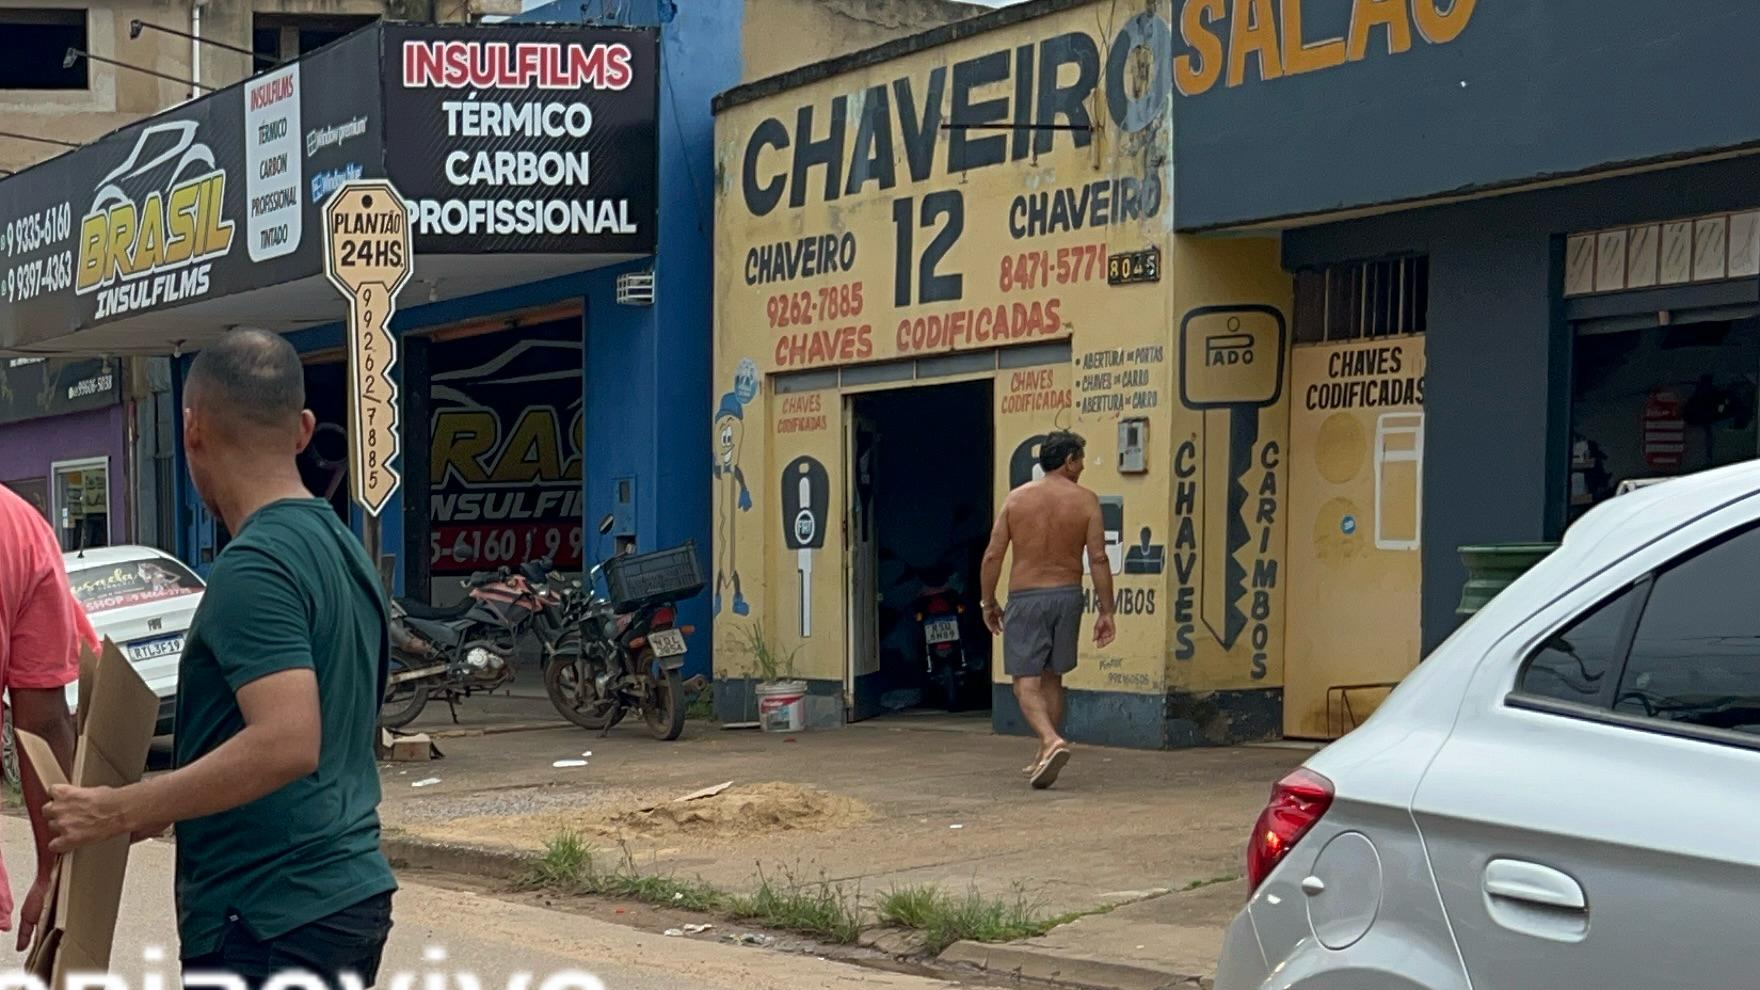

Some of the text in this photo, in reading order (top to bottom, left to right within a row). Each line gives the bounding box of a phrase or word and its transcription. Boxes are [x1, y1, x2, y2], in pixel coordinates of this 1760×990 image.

[403, 41, 633, 91] INSULFILMS
[250, 74, 294, 112] INSULFILMS
[443, 92, 592, 138] TÉRMICO
[742, 15, 1171, 216] CHAVEIRO
[259, 153, 288, 180] CARBON
[445, 151, 589, 187] CARBON
[251, 186, 297, 218] PROFISSIONAL
[1009, 172, 1162, 240] CHAVEIRO
[75, 168, 236, 295] BRASIL
[260, 224, 288, 249] TINTADO
[334, 210, 400, 234] PLANTÃO
[745, 231, 856, 286] CHAVEIRO
[892, 189, 964, 308] 12
[94, 263, 212, 320] INSULFILMS
[775, 300, 1061, 366] CHAVES CODIFICADAS
[1083, 349, 1123, 369] ABERTURA
[1329, 347, 1402, 378] CHAVES
[1011, 369, 1053, 392] CHAVES
[1082, 373, 1111, 391] CHAVES
[1122, 369, 1149, 387] CARRO
[1306, 377, 1425, 410] CODIFICADAS
[782, 394, 821, 414] CHAVES
[1001, 389, 1071, 414] CODIFICADAS
[1082, 394, 1123, 413] ABERTURA
[1132, 391, 1157, 408] CARRO
[777, 416, 828, 433] CODIFICADAS
[431, 405, 582, 490] RA
[1174, 441, 1196, 660] CHAVES
[1250, 441, 1280, 679] CARIMBOS
